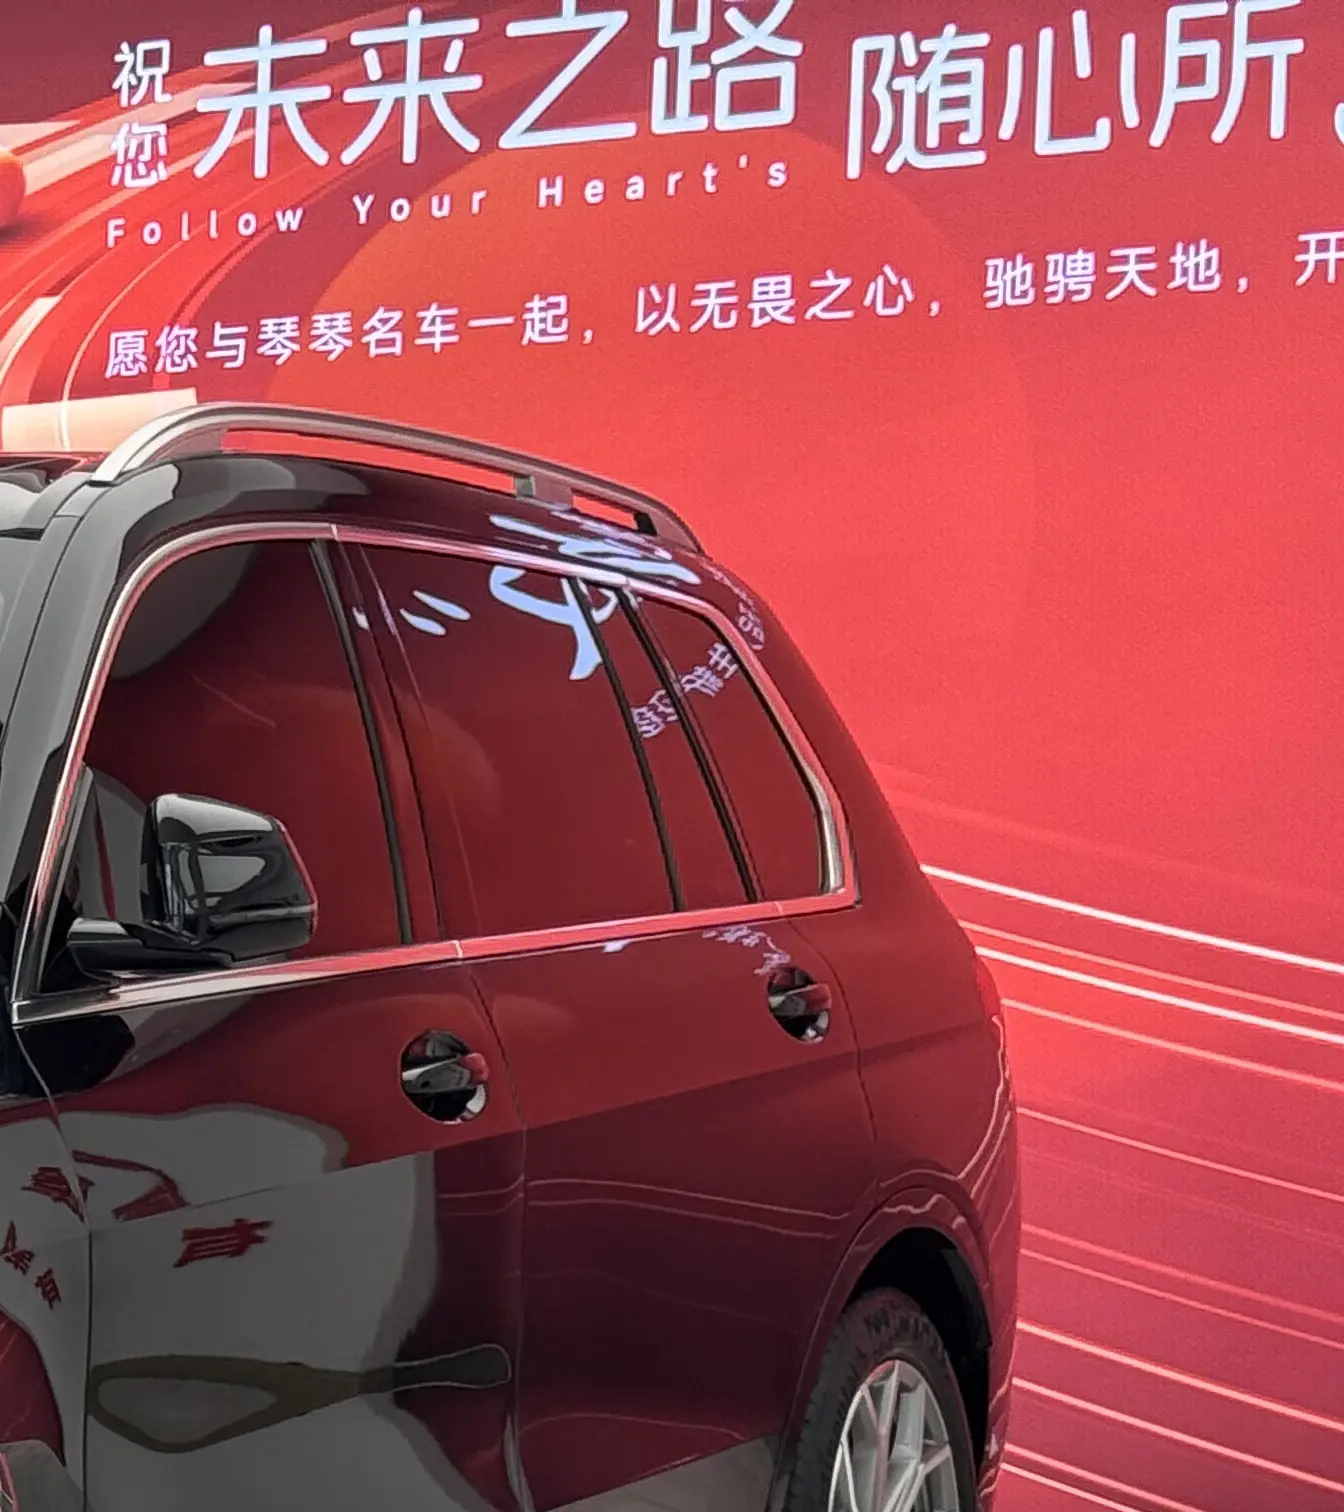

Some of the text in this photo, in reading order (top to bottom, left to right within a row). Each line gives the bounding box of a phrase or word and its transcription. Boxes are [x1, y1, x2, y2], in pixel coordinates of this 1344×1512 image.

[110, 38, 173, 189] 祝您
[194, 0, 1344, 179] 未来之路 随心所
[106, 155, 789, 248] Follow Your Heart's
